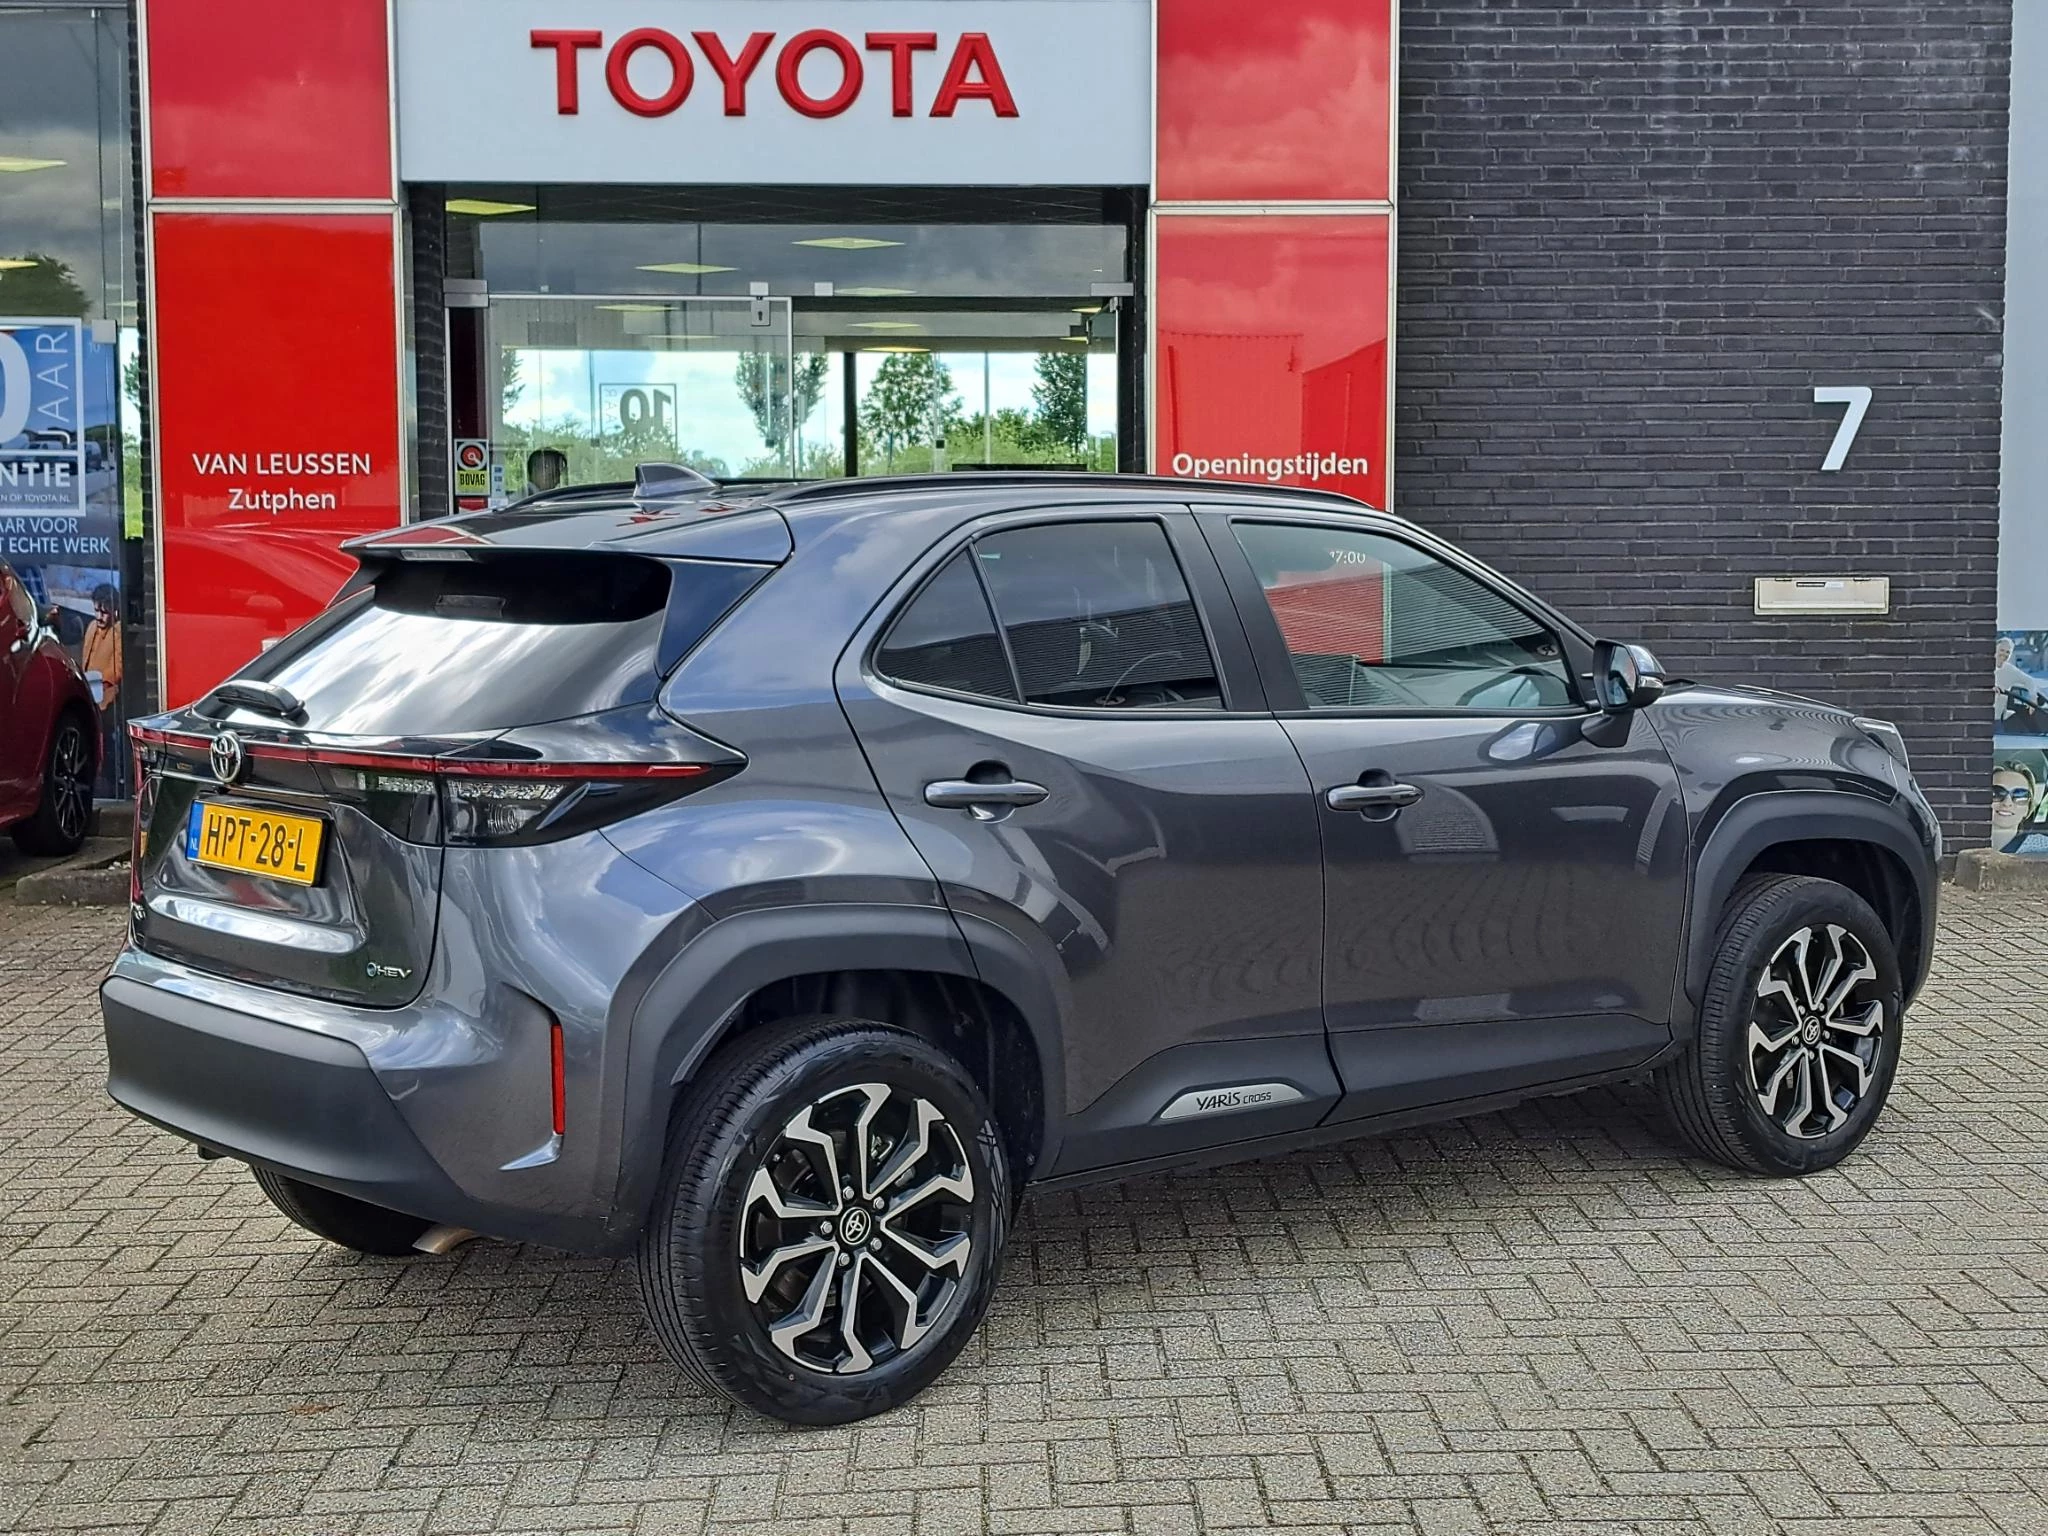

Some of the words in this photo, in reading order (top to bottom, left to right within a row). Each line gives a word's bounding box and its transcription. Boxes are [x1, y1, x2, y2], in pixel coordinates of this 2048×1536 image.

[530, 27, 1020, 119] TOYOTA
[36, 331, 71, 445] JAAR
[1814, 386, 1873, 471] 7
[192, 453, 247, 475] VAN
[256, 453, 371, 475] LEUSSEN
[1172, 452, 1368, 481] Openingstijden
[460, 473, 486, 486] BOVAG
[228, 488, 337, 515] Zutphen
[29, 517, 79, 534] VOOR
[8, 536, 59, 553] ECHTE
[62, 536, 111, 553] WERK
[190, 837, 199, 851] NL
[205, 813, 306, 872] HPT-28-L
[377, 965, 412, 978] HEV
[1243, 1092, 1272, 1104] CROSS
